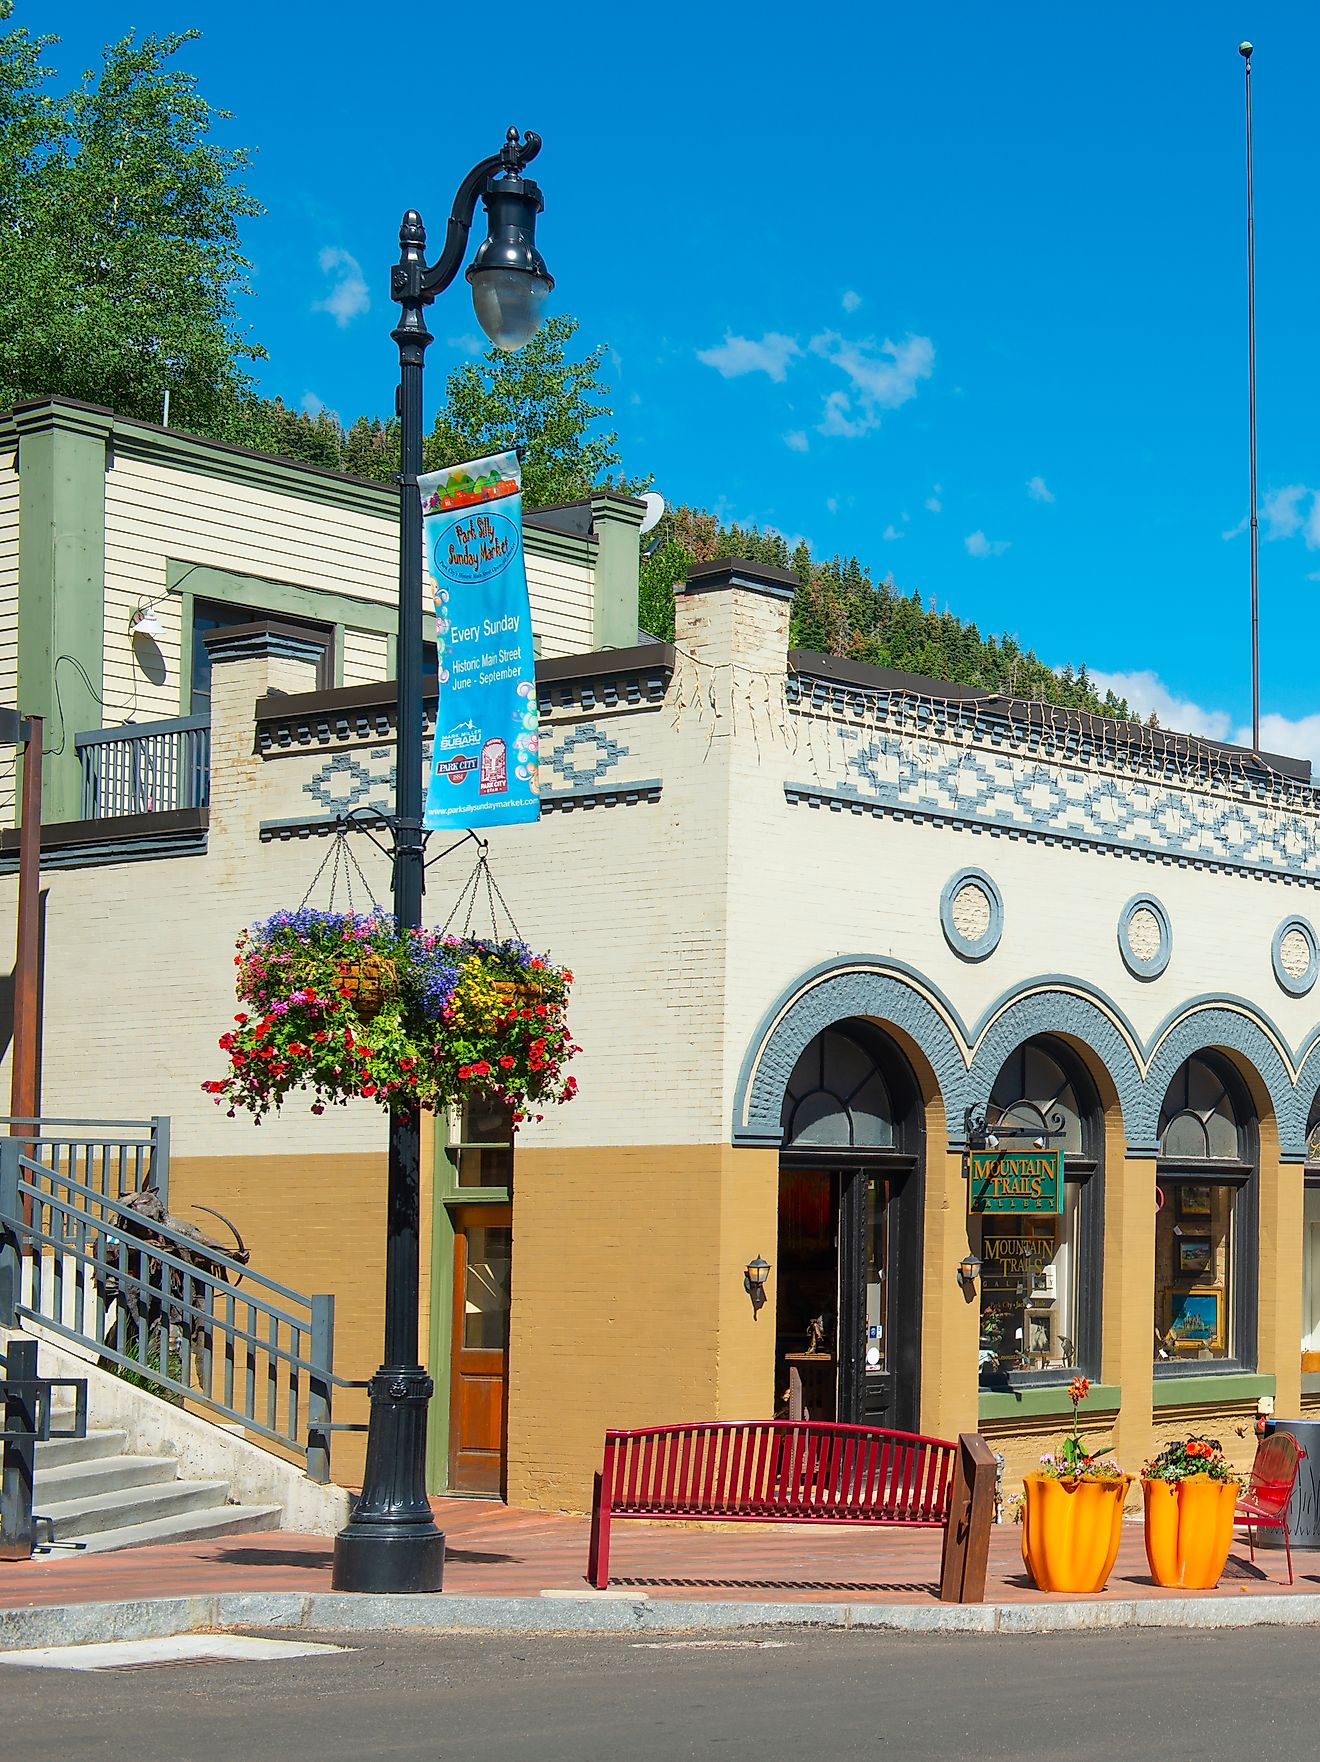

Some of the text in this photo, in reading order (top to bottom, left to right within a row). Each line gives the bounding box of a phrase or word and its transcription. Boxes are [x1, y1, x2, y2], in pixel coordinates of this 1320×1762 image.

[455, 516, 495, 545] Park Silly
[448, 544, 479, 572] Sunday
[480, 536, 508, 563] Market
[451, 614, 520, 643] Every Sunday
[452, 646, 521, 674] Historic Main Street
[452, 678, 472, 691] June
[479, 666, 522, 685] September
[441, 733, 482, 748] SUBARU
[440, 759, 477, 772] PARK CITY
[973, 1159, 1056, 1180] MOUNTAIN
[990, 1178, 1042, 1199] TRAILS
[973, 1199, 1055, 1208] GALLERY
[984, 1240, 1054, 1259] MOUNTAIN
[1000, 1258, 1043, 1277] TRAILS
